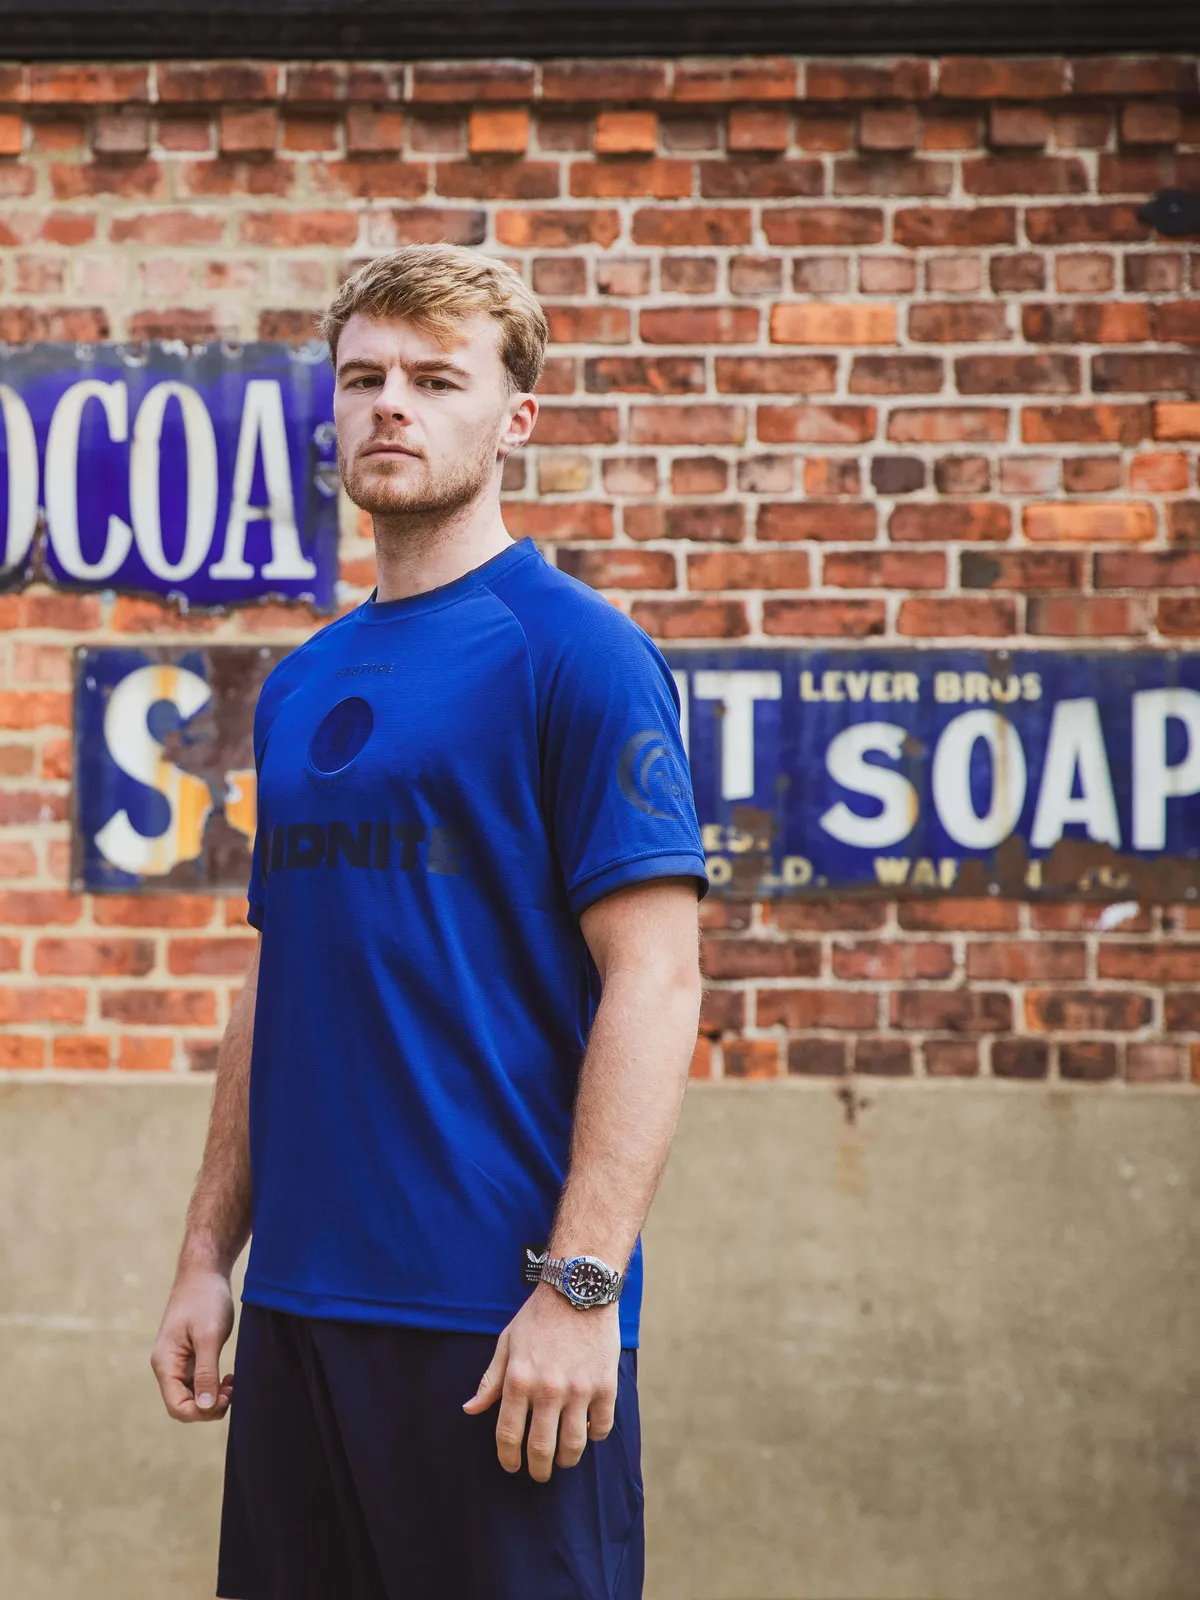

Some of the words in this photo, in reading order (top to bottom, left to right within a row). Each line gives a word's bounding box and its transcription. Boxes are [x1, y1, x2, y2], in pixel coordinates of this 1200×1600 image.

[800, 670, 920, 702] LEVER
[820, 686, 1200, 852] SOAP
[260, 821, 462, 876] IDNITE
